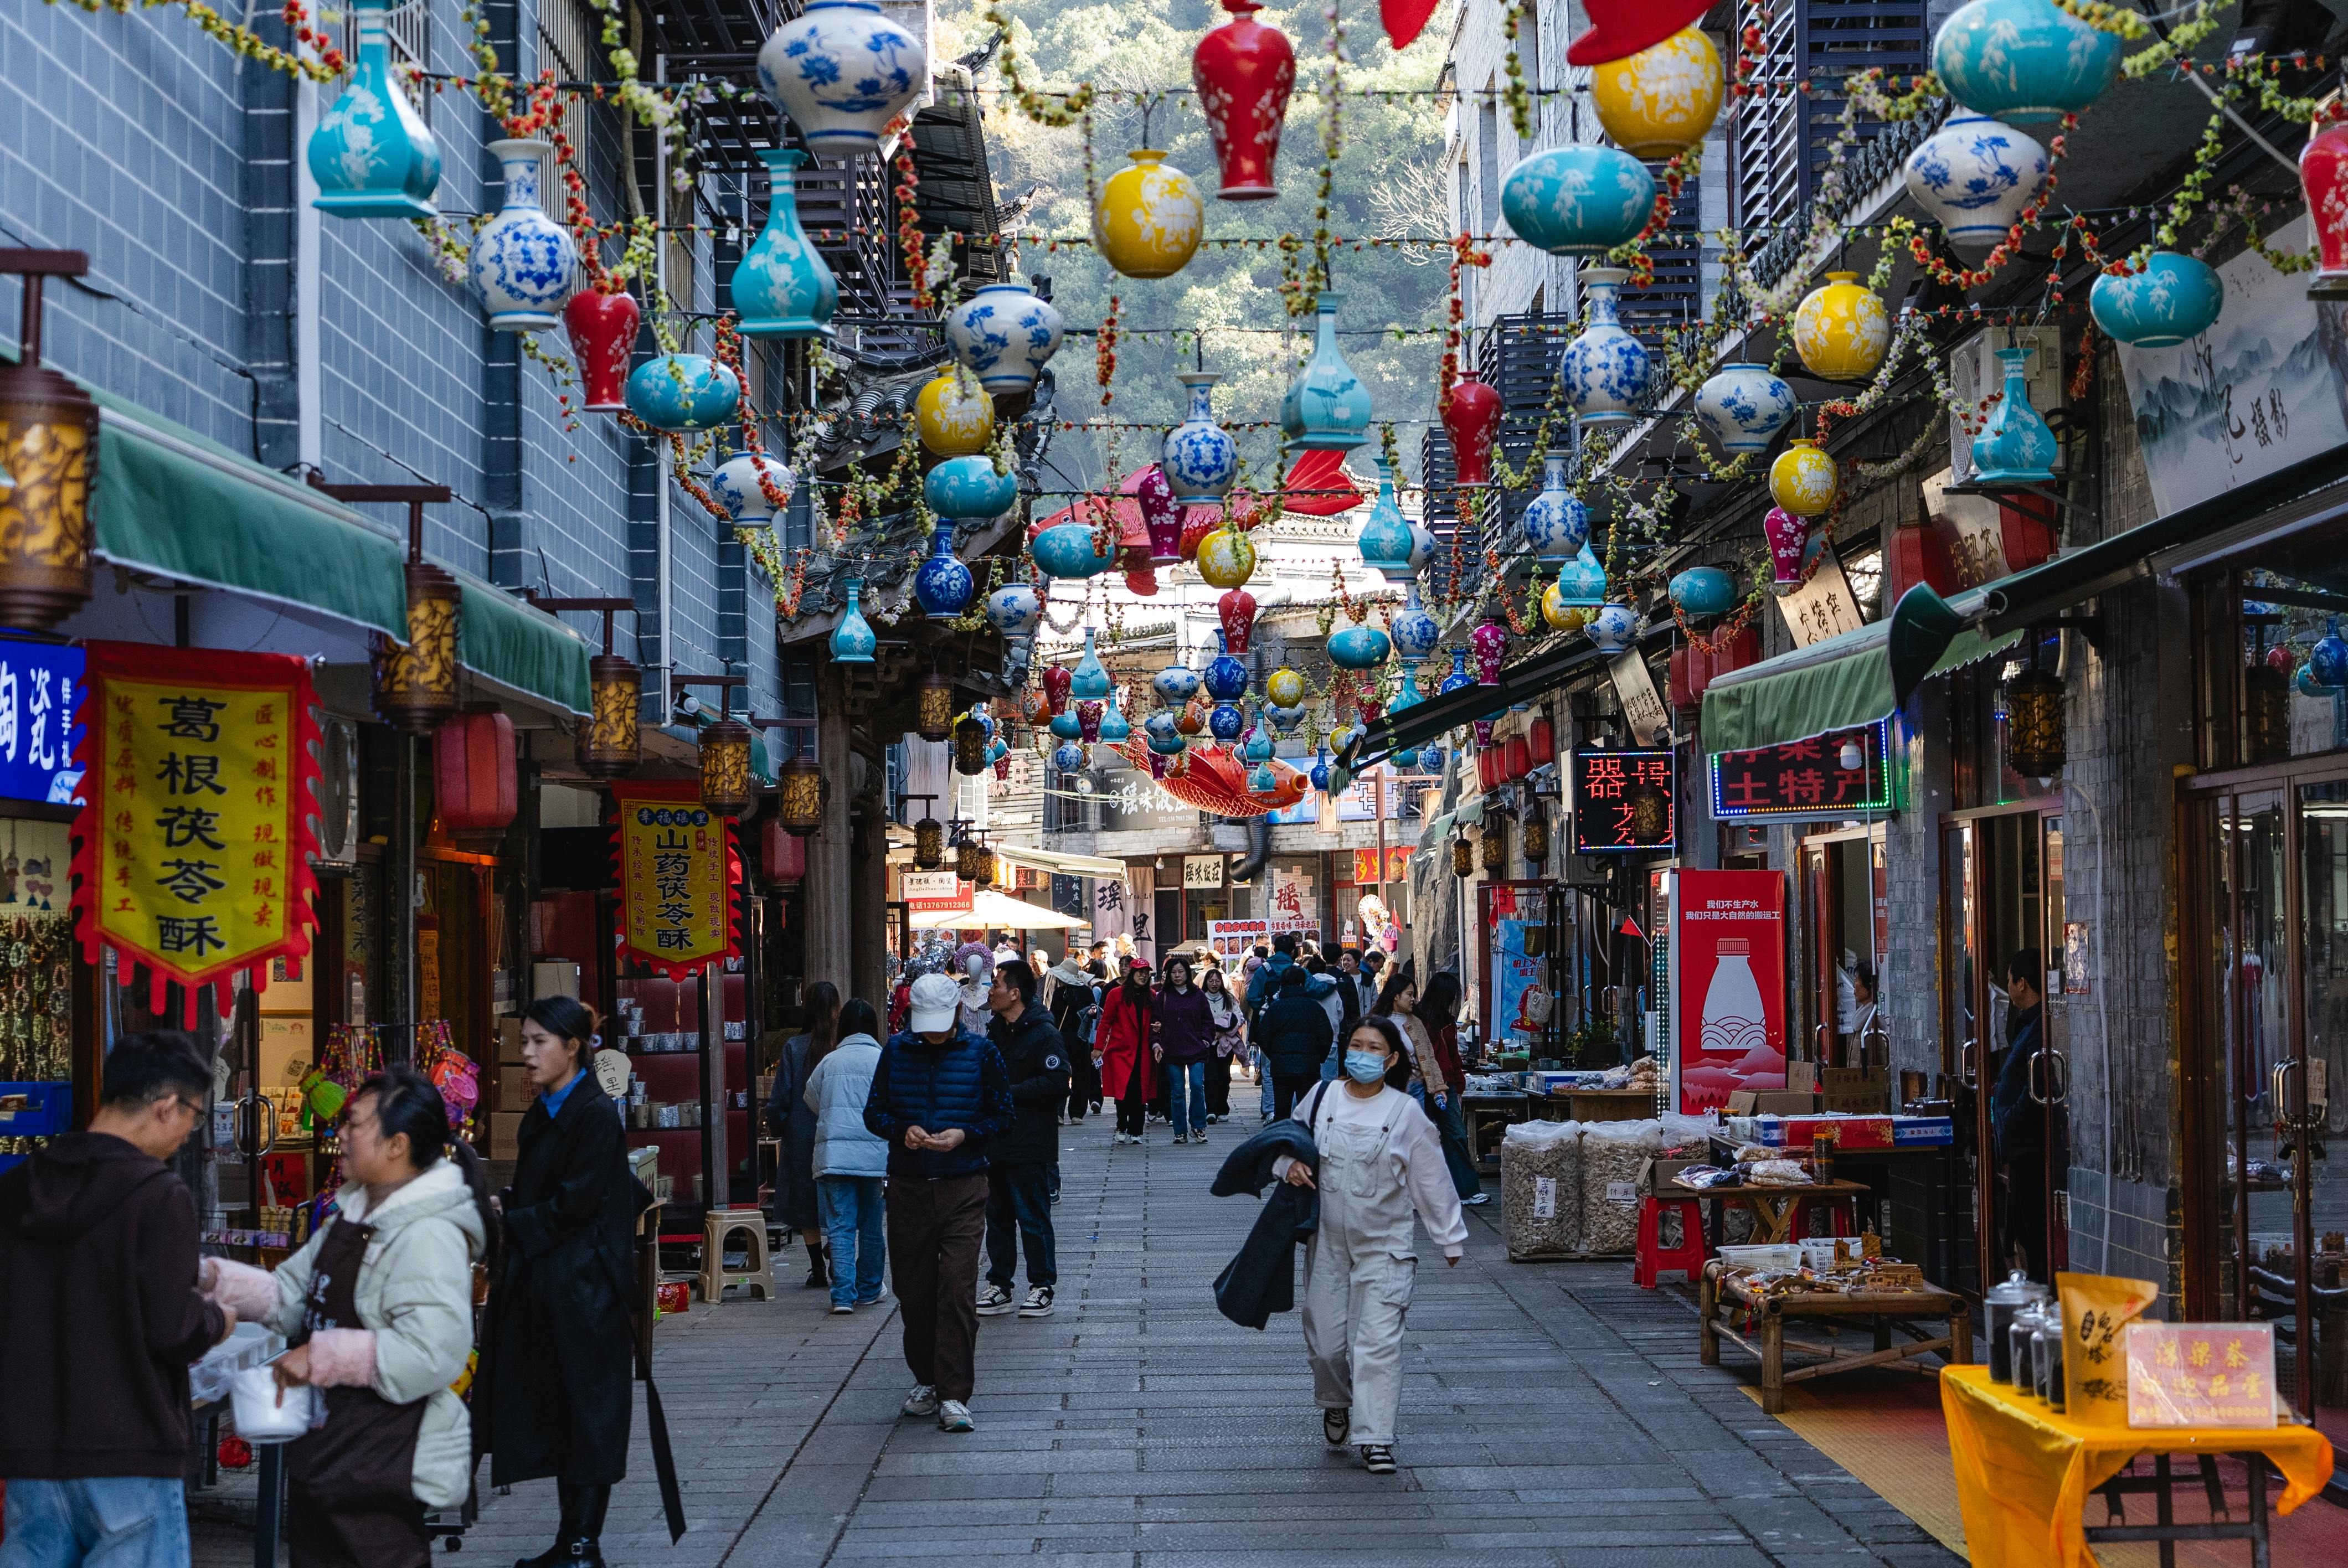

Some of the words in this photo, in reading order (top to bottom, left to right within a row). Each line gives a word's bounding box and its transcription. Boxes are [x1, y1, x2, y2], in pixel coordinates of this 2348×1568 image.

[114, 694, 138, 799] 优质原料
[251, 703, 279, 808] 匠心制作
[1725, 768, 1878, 806] 土特产
[155, 695, 228, 957] 葛根茯苓酥
[637, 808, 709, 826] 幸福瑶里
[113, 809, 137, 914] 传统手工
[251, 823, 280, 929] 现做现卖
[631, 835, 644, 881] 传承经典
[653, 828, 694, 951] 山药茯苓酥
[1707, 900, 1759, 909] 我们不生产水
[634, 891, 646, 937] 匠心制作
[709, 891, 720, 939] 现做现卖
[1685, 911, 1781, 920] 我们只是大自然的搬运工
